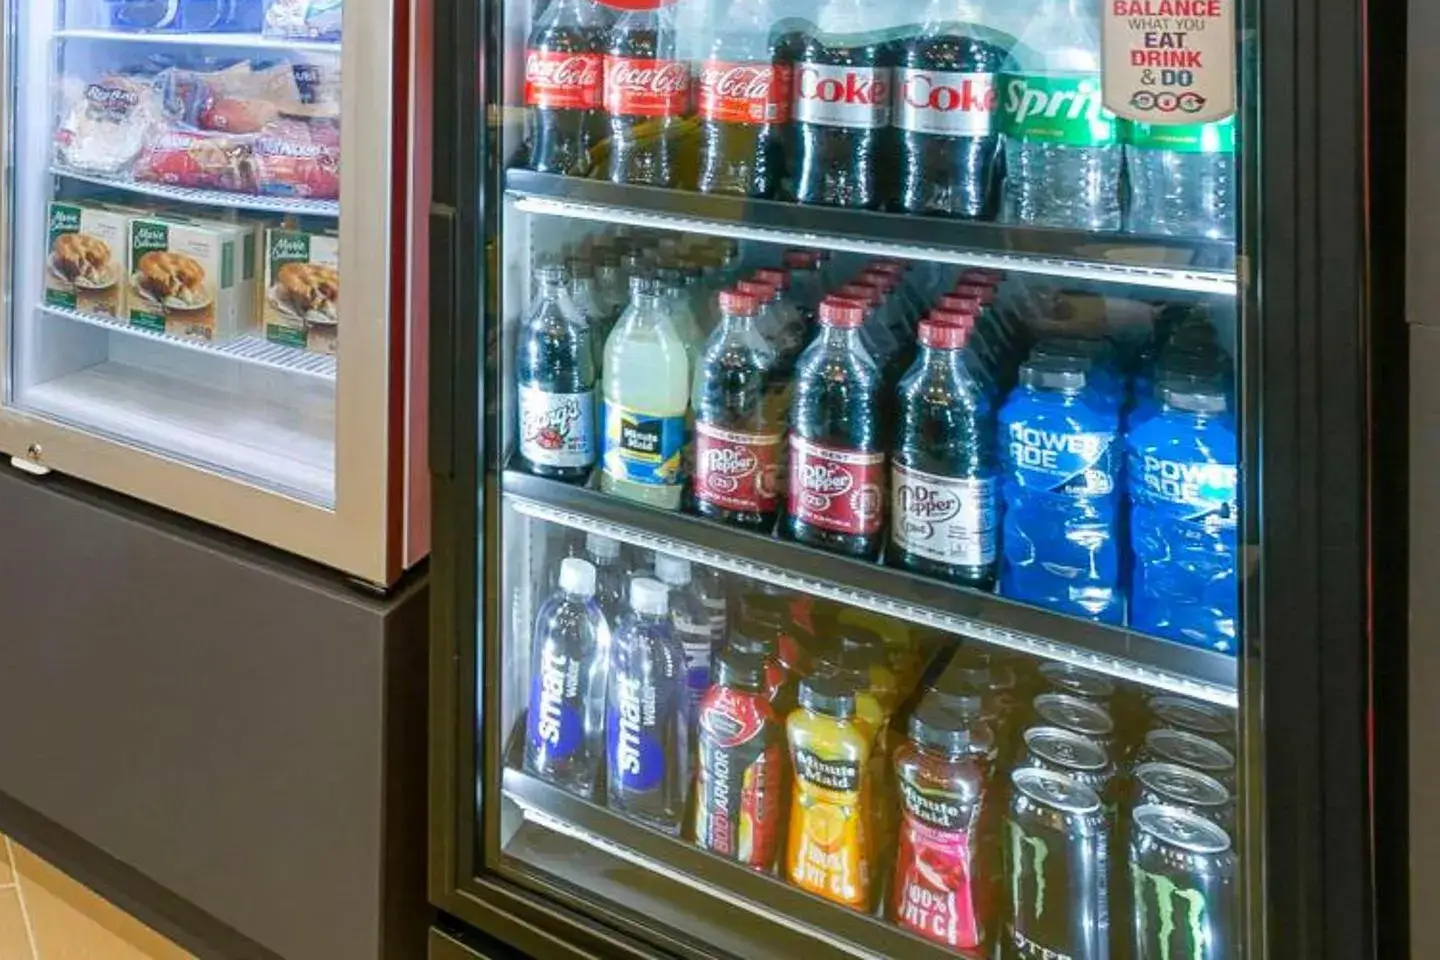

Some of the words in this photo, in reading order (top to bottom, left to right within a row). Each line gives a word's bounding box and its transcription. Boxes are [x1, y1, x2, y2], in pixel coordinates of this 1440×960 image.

[1113, 0, 1221, 17] BALANCE
[1128, 18, 1169, 31] WHAT
[1175, 19, 1205, 32] YOU
[1144, 32, 1187, 49] EAT
[1130, 50, 1203, 68] DRINK
[798, 69, 885, 105] Coke
[1140, 69, 1156, 86] &
[1161, 70, 1193, 87] DO
[904, 73, 997, 113] Coke
[1004, 80, 1112, 124] Sprit
[915, 486, 939, 501] Dr
